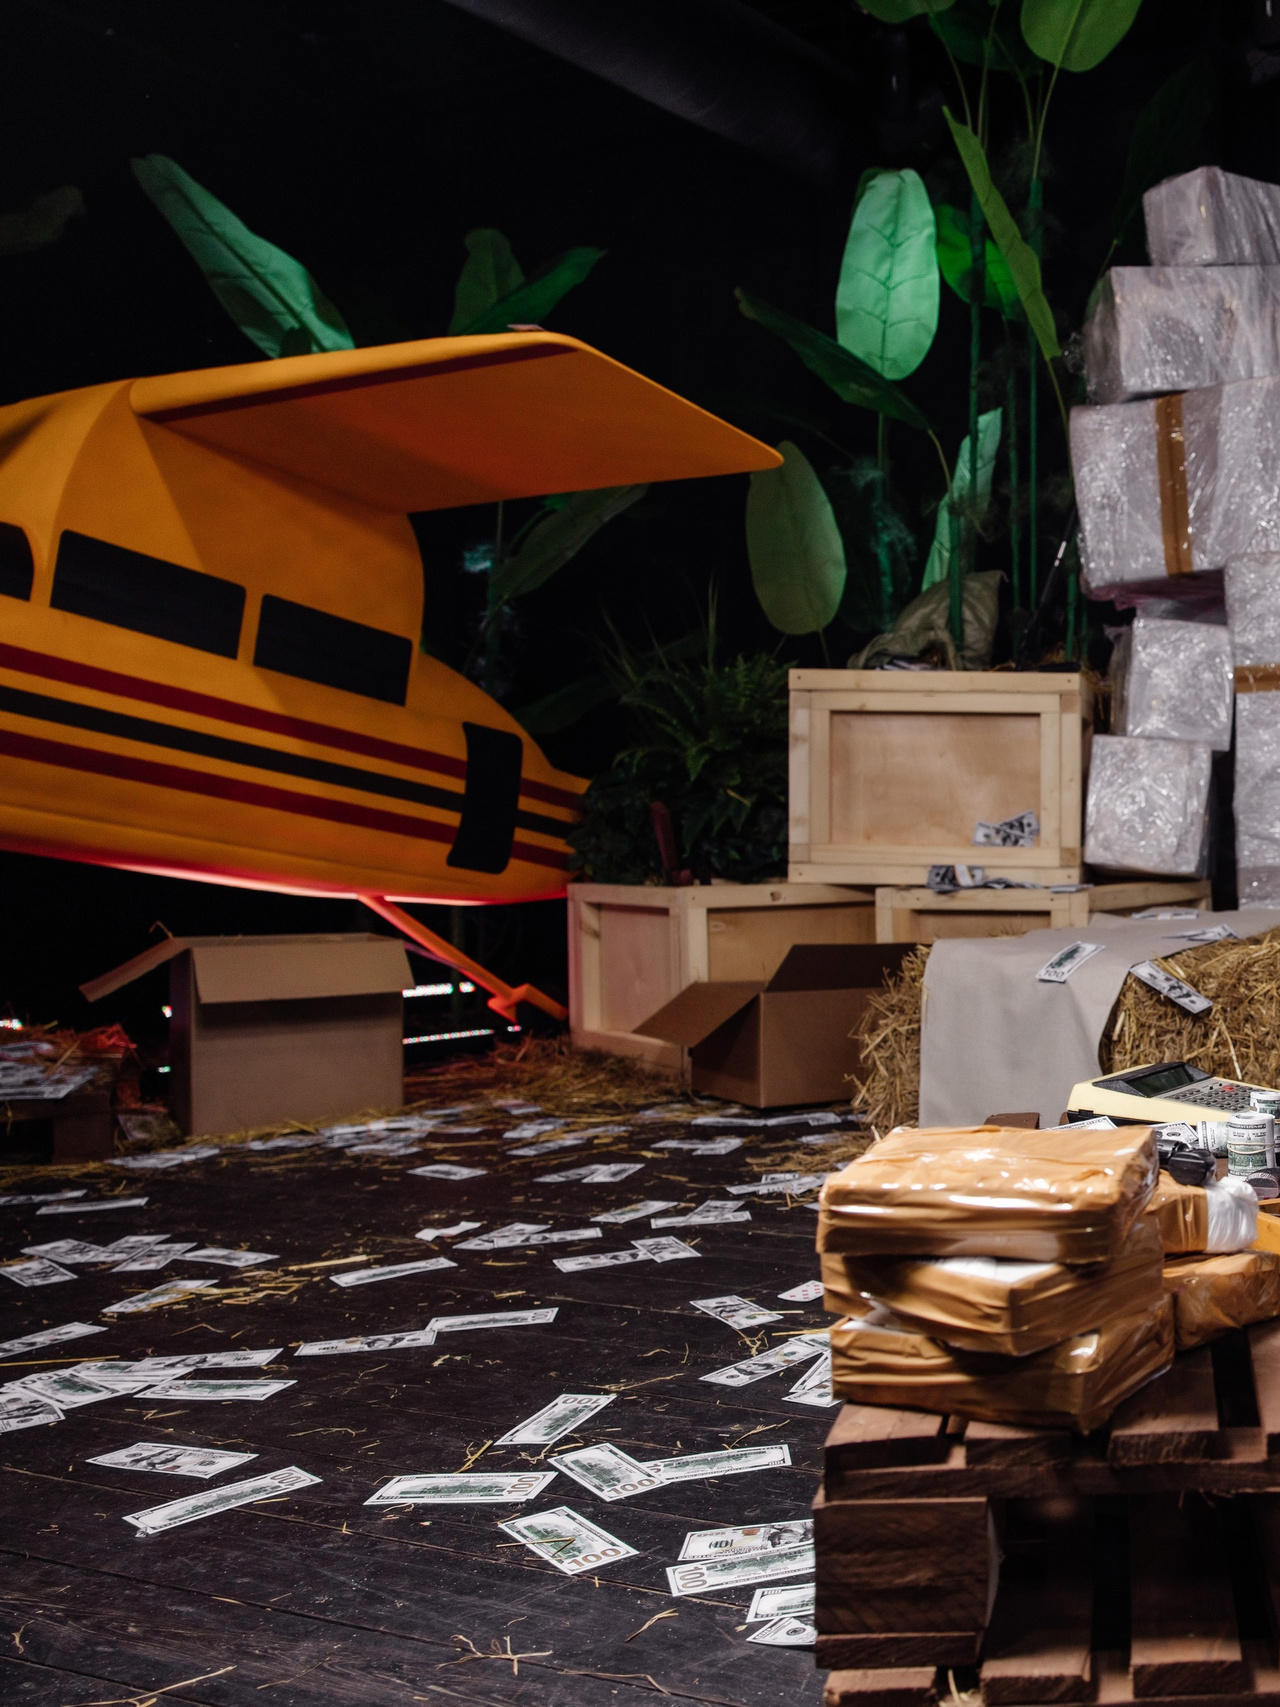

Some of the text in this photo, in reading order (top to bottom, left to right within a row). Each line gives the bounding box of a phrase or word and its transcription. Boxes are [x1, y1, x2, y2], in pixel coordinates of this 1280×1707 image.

[1044, 969, 1065, 979] 100
[562, 1397, 601, 1405] 100
[270, 1471, 307, 1487] 100
[506, 1475, 541, 1495] 100
[607, 1478, 656, 1496] 100
[567, 1548, 621, 1568] 100
[678, 1566, 708, 1589] 100
